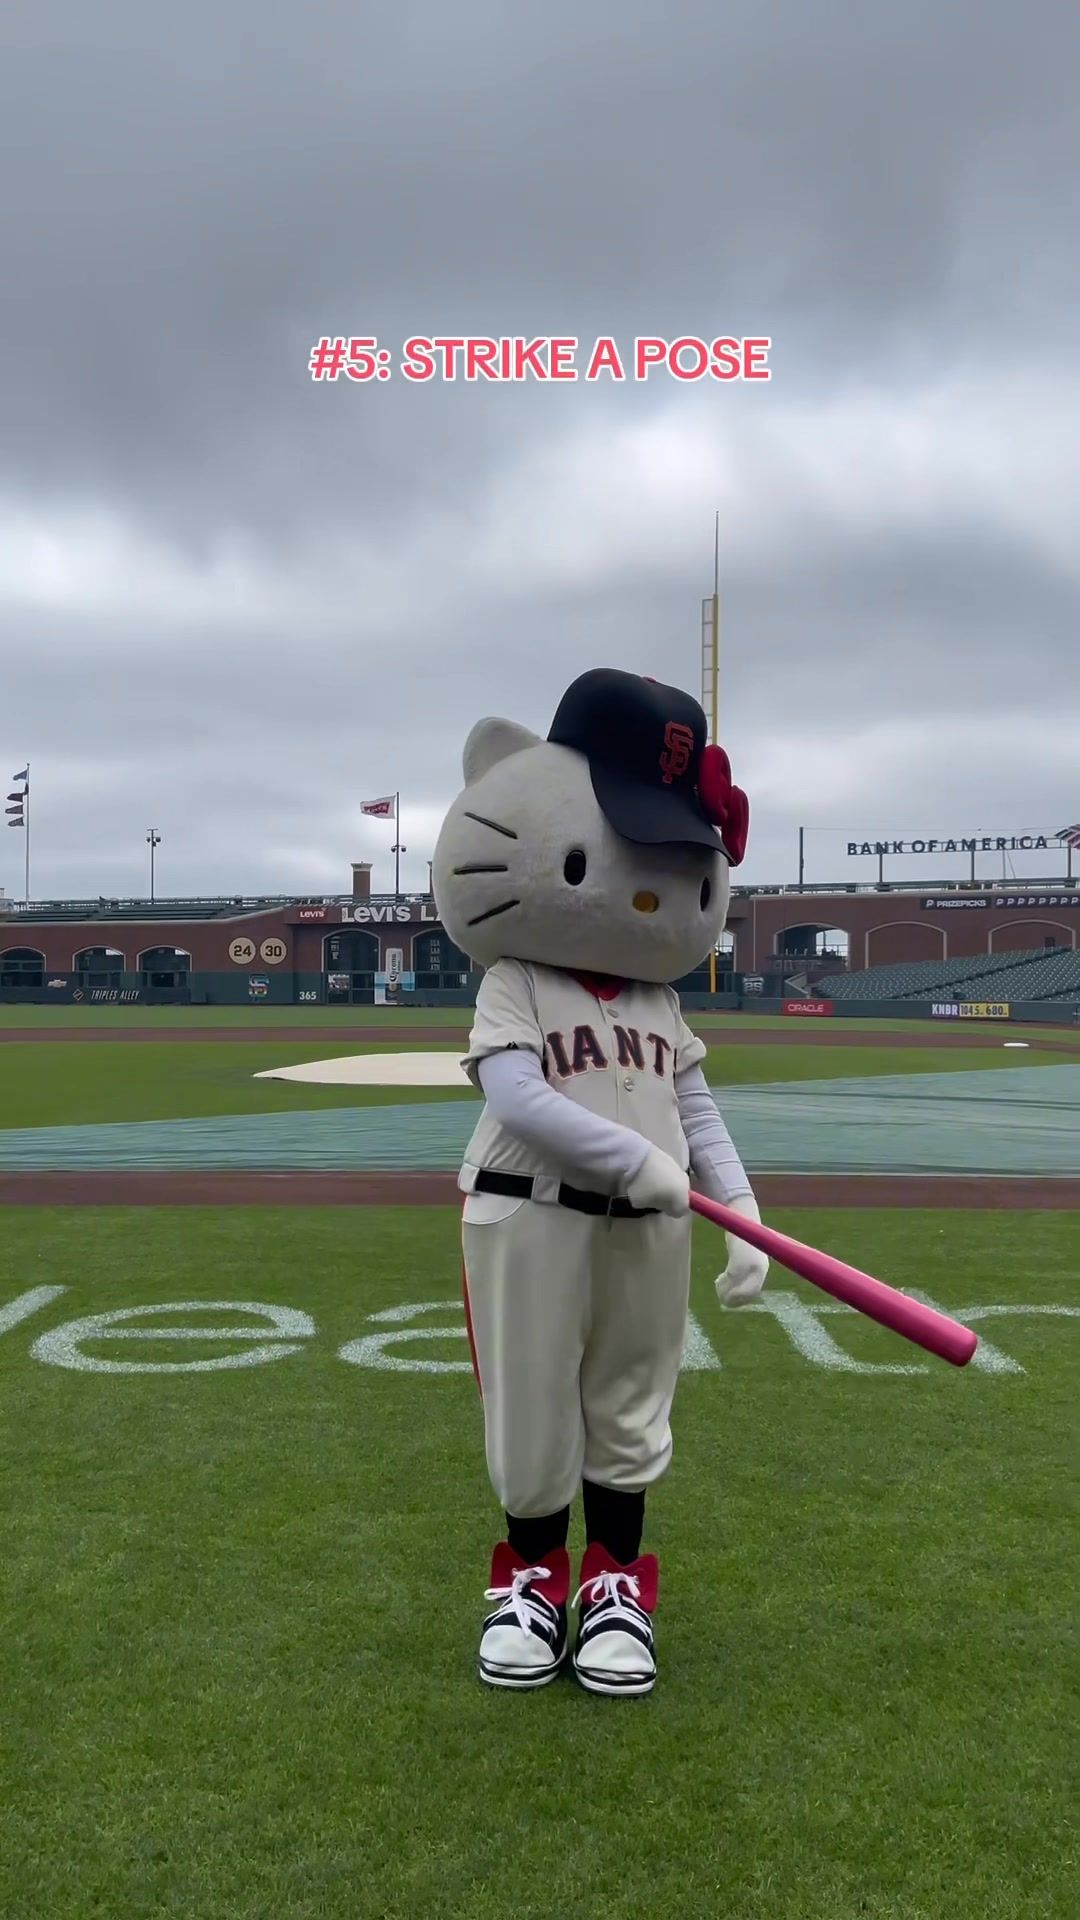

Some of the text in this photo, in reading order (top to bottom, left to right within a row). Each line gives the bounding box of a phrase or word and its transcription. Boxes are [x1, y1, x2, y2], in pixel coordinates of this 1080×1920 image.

[847, 835, 1048, 856] BANK OF AMERICA
[233, 945, 251, 957] 24
[265, 945, 282, 957] 30
[91, 990, 140, 1000] TRIPLES ALLEY
[299, 991, 317, 1000] 365
[787, 1003, 824, 1013] ORACLE
[932, 1003, 958, 1016] KNBR
[546, 1024, 673, 1080] IANT
